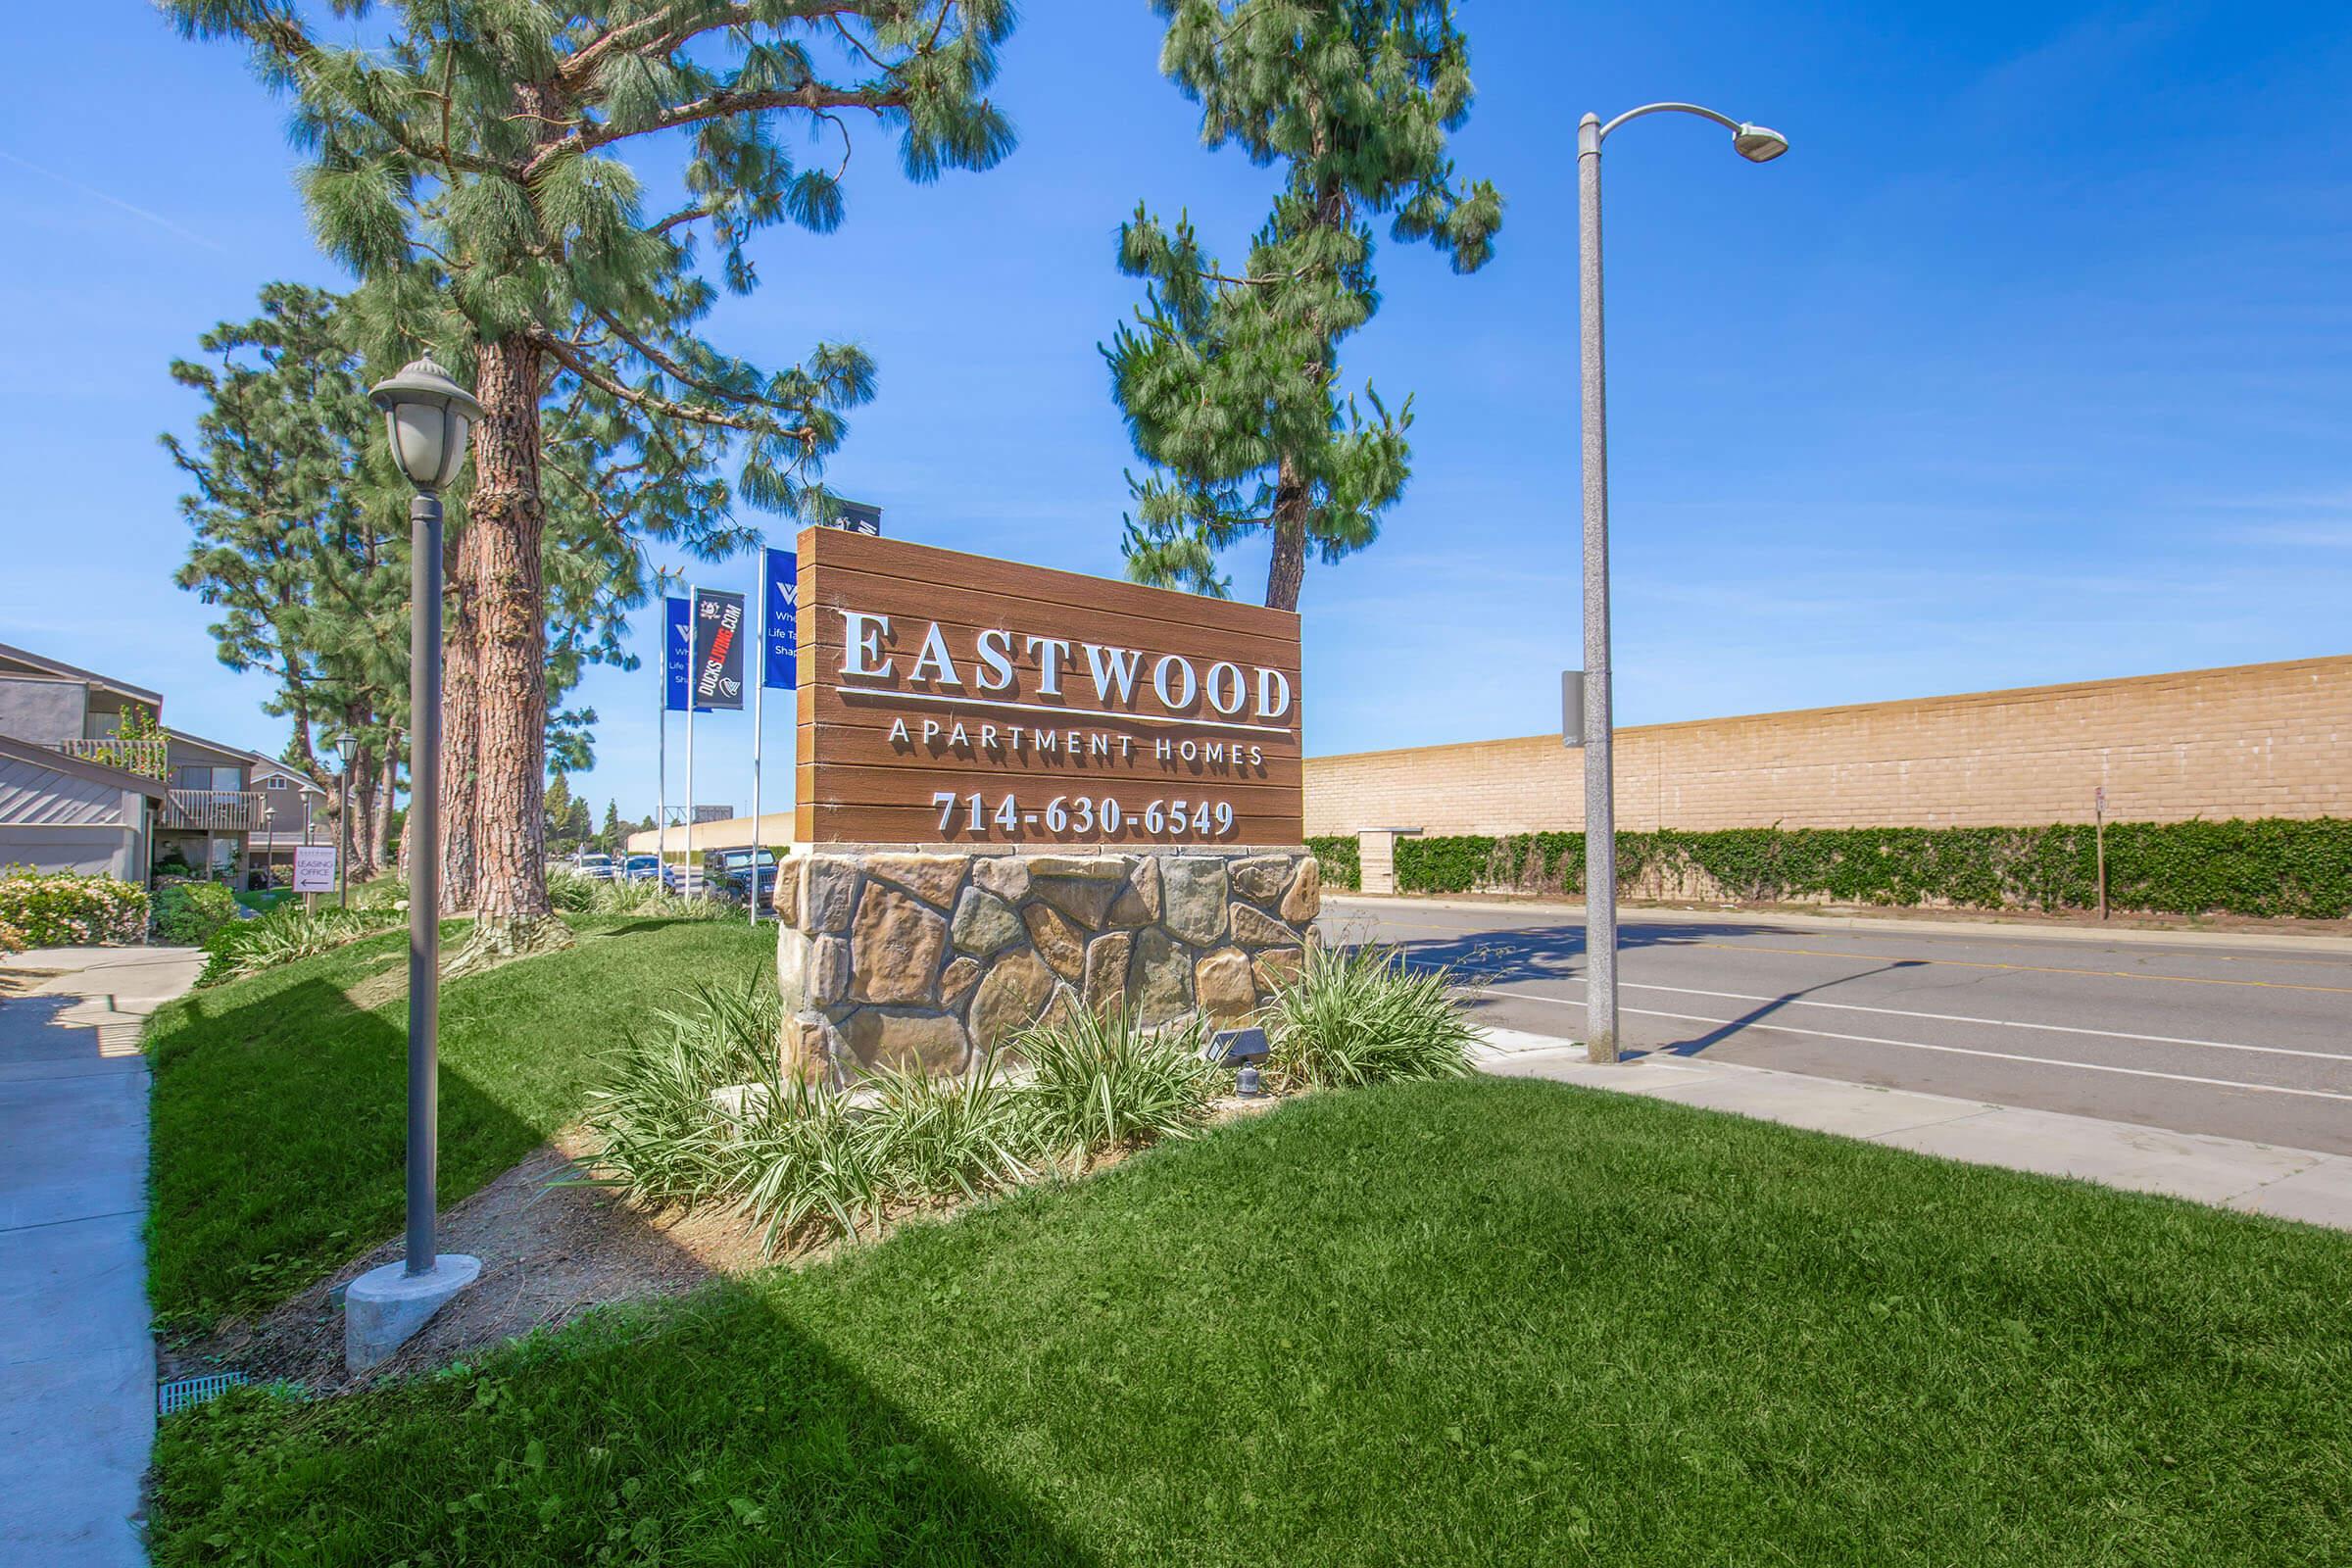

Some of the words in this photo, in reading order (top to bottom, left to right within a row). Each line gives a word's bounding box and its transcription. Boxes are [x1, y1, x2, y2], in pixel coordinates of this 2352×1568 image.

[767, 628, 785, 639] Life
[838, 609, 1293, 719] EASTWOOD
[888, 717, 1133, 758] APARTMENT
[1155, 739, 1263, 766] HOMES
[932, 791, 1234, 836] 714-630-6549
